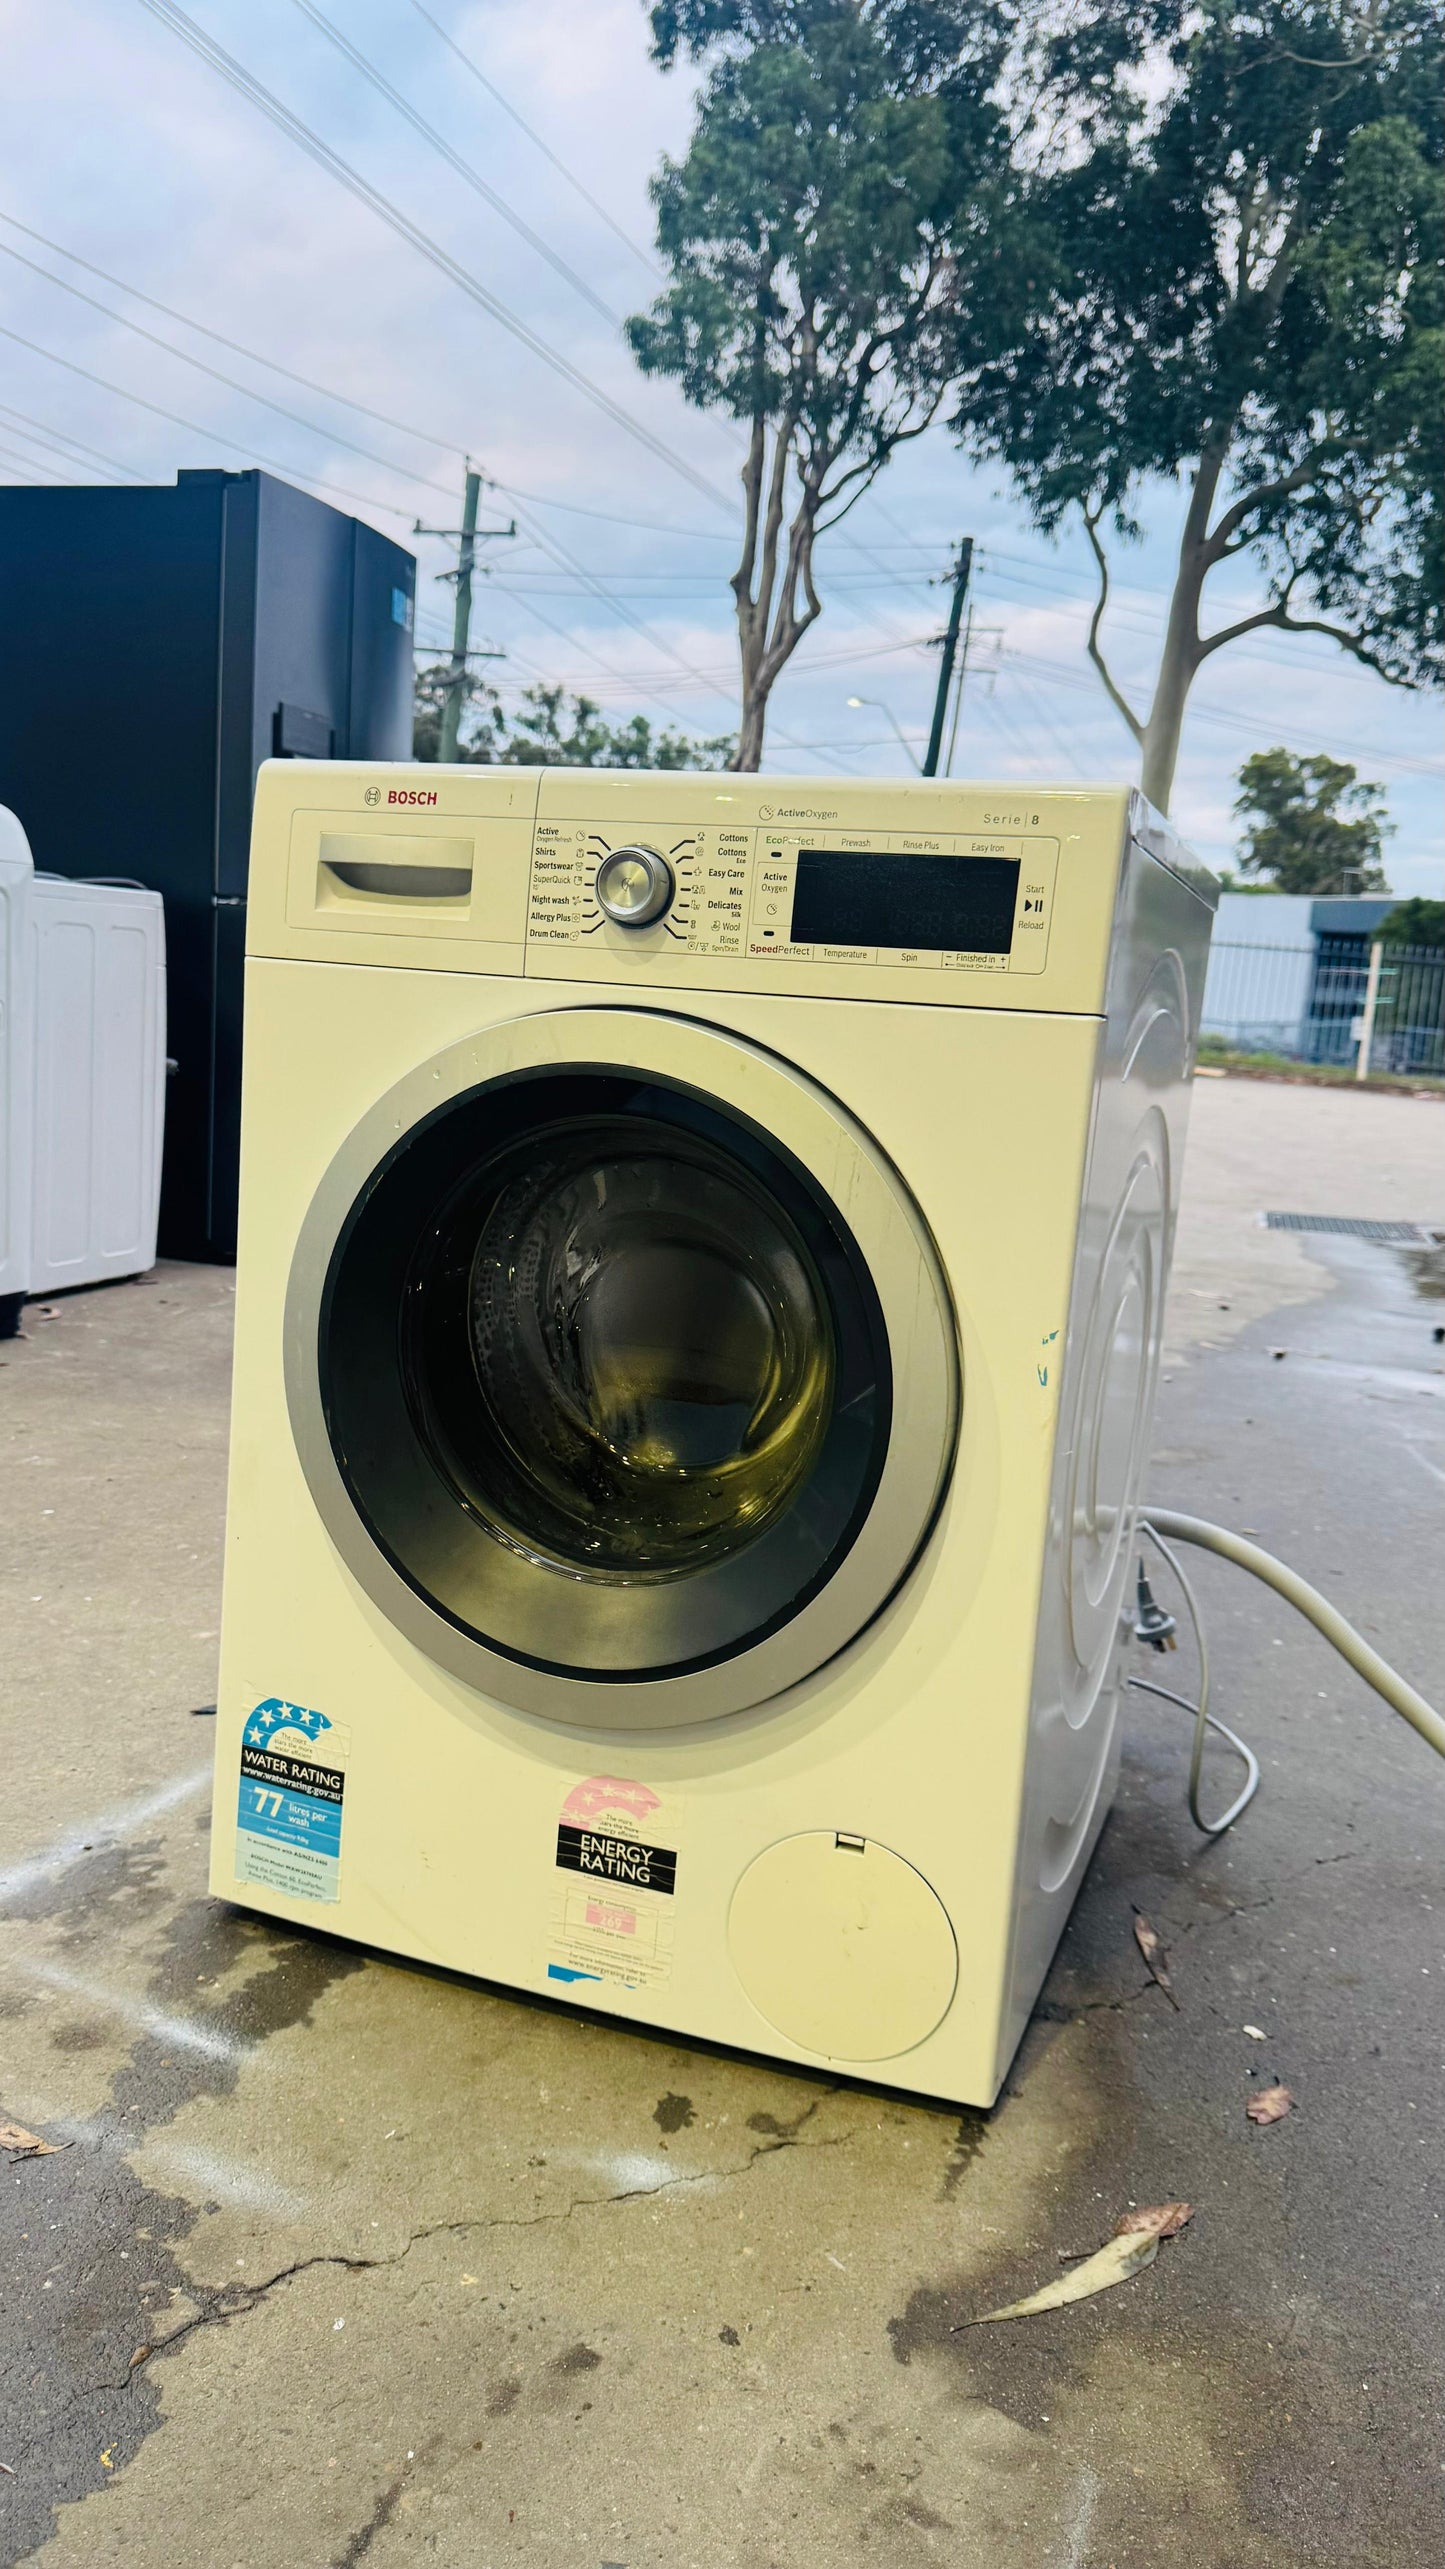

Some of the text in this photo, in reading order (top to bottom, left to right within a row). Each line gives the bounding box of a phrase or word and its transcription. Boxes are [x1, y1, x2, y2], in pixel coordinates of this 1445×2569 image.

[387, 790, 438, 806] BOSCH
[776, 808, 838, 820] ActiveOxygen
[983, 813, 1040, 826] Serie 8
[537, 827, 559, 835] Active
[719, 833, 749, 843] Cottons
[841, 838, 871, 847] Prewash
[902, 840, 940, 850] Rinse Plus
[971, 843, 1005, 852] Easy Iron
[535, 847, 556, 856] Shirts
[717, 848, 747, 856] Cottons
[534, 861, 574, 871] Sportswear
[708, 868, 745, 878] Easy Care
[763, 872, 788, 881] Active
[533, 874, 571, 884] SuperQuick
[729, 887, 743, 896] Mix
[761, 883, 788, 894] Oxygen
[1025, 884, 1045, 894] Start
[531, 895, 570, 905] Night wash
[707, 900, 742, 910] Delicates
[530, 912, 571, 922] Allergy Plus
[722, 923, 741, 931] Wool
[1018, 920, 1044, 930] Reload
[529, 929, 569, 939] Drum Clean
[719, 935, 740, 945] Rinse
[750, 944, 810, 956] SpeedPerfect
[823, 948, 868, 959] Temperature
[901, 953, 918, 962] Spin
[956, 953, 988, 964] Finished
[244, 1749, 341, 1789] WATER RATING
[242, 1766, 341, 1800] www.waterrating.gov.au
[253, 1786, 285, 1818] 77
[289, 1802, 328, 1823] litres per
[288, 1815, 310, 1828] wash
[580, 1833, 654, 1866] ENERGY
[580, 1851, 651, 1884] RATING
